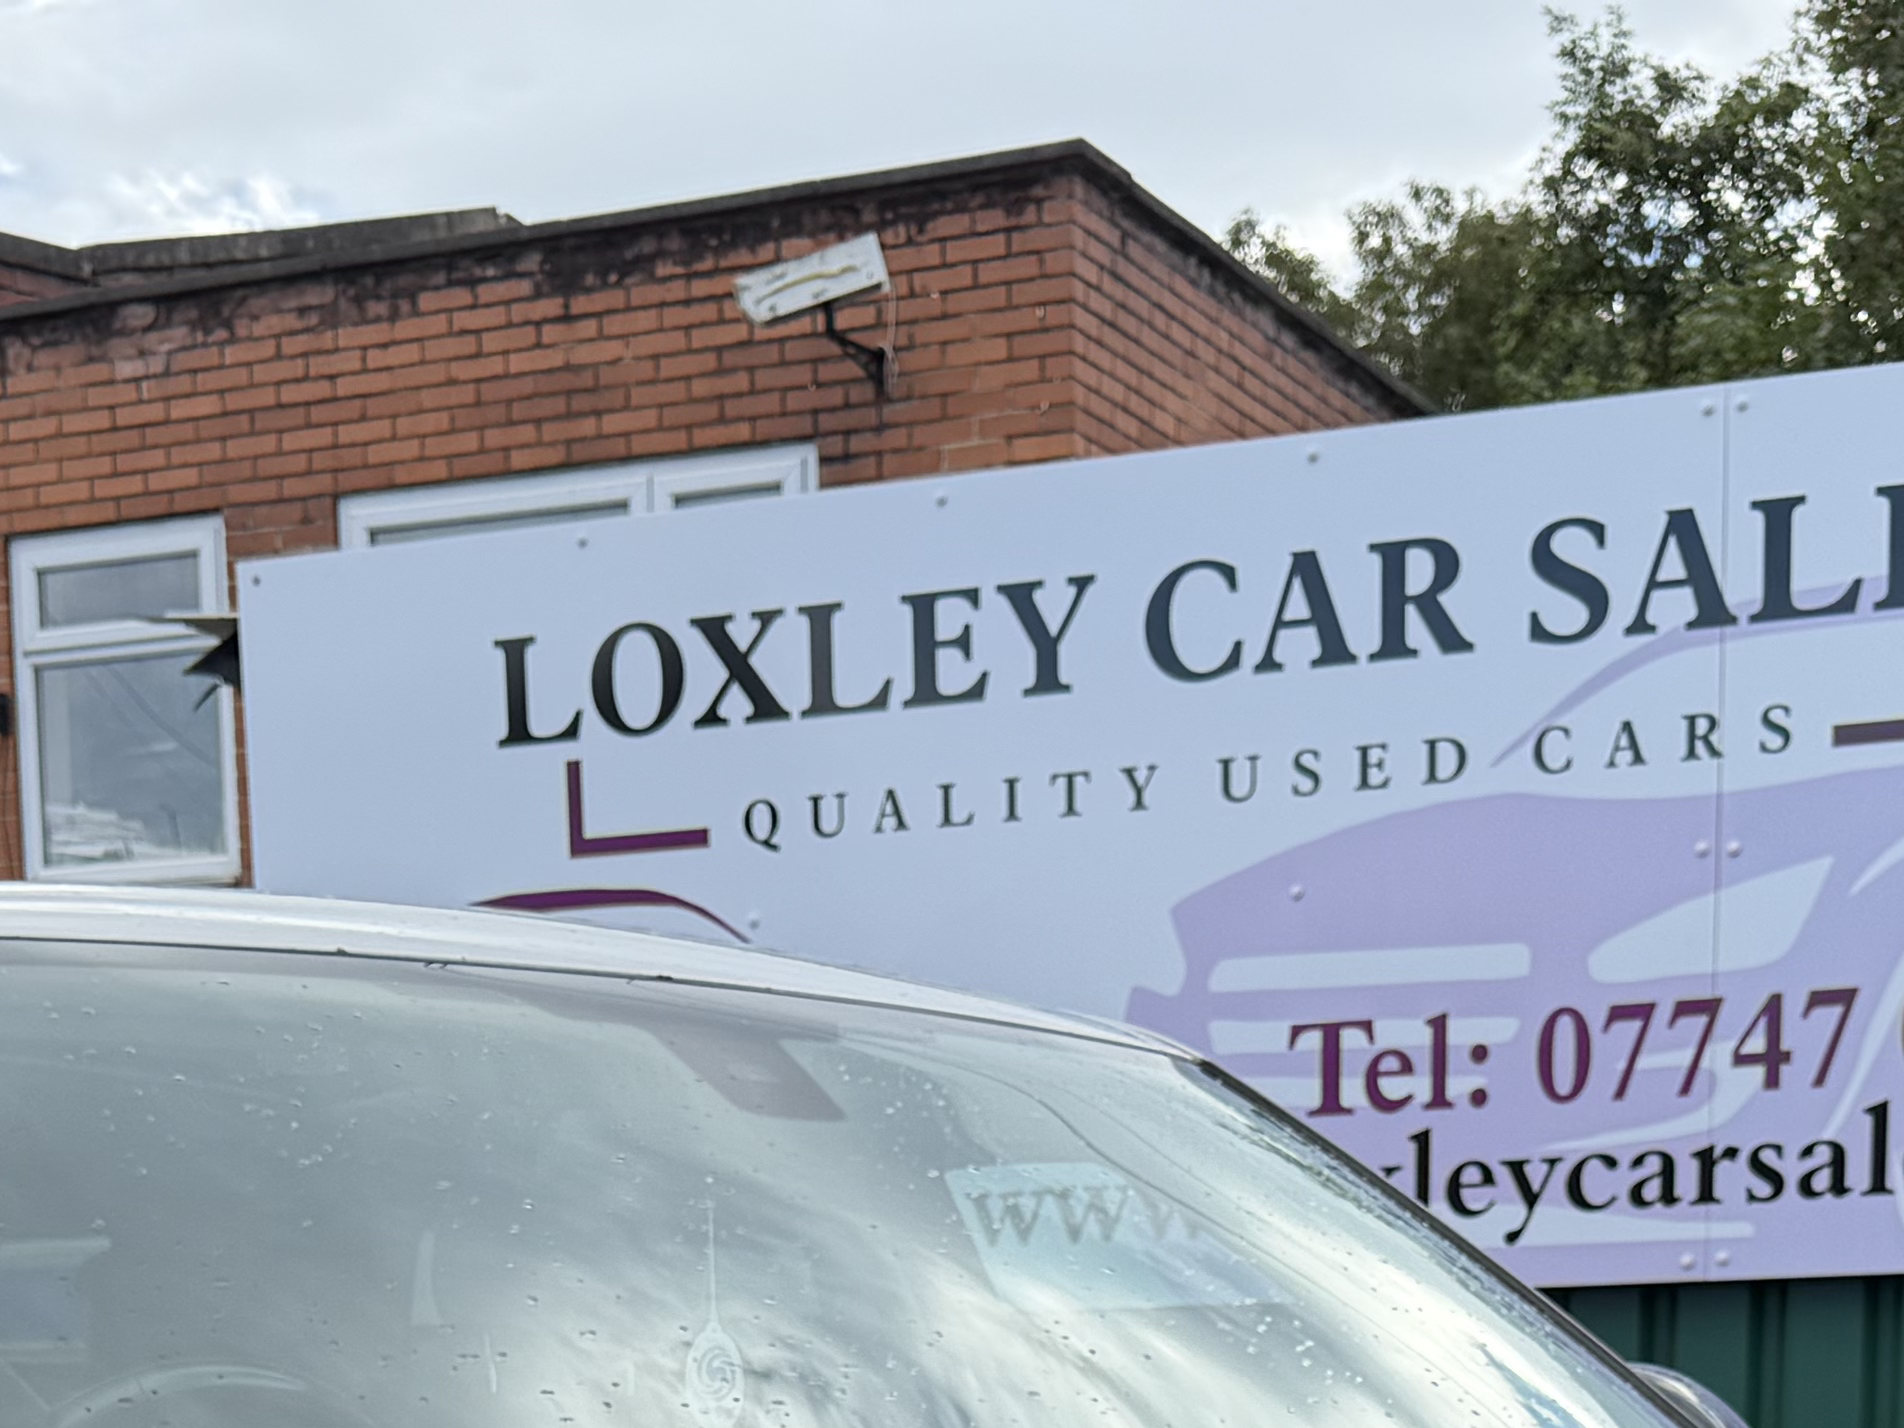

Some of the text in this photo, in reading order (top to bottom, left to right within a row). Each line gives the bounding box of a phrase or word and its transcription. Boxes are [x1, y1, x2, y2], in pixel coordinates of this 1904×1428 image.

[493, 573, 1096, 748] LOXLEY
[1143, 535, 1475, 684] CAR
[742, 703, 1795, 854] QUALITY USED CARS
[1289, 1012, 1490, 1118] Tel:
[1536, 986, 1860, 1105] 07747
